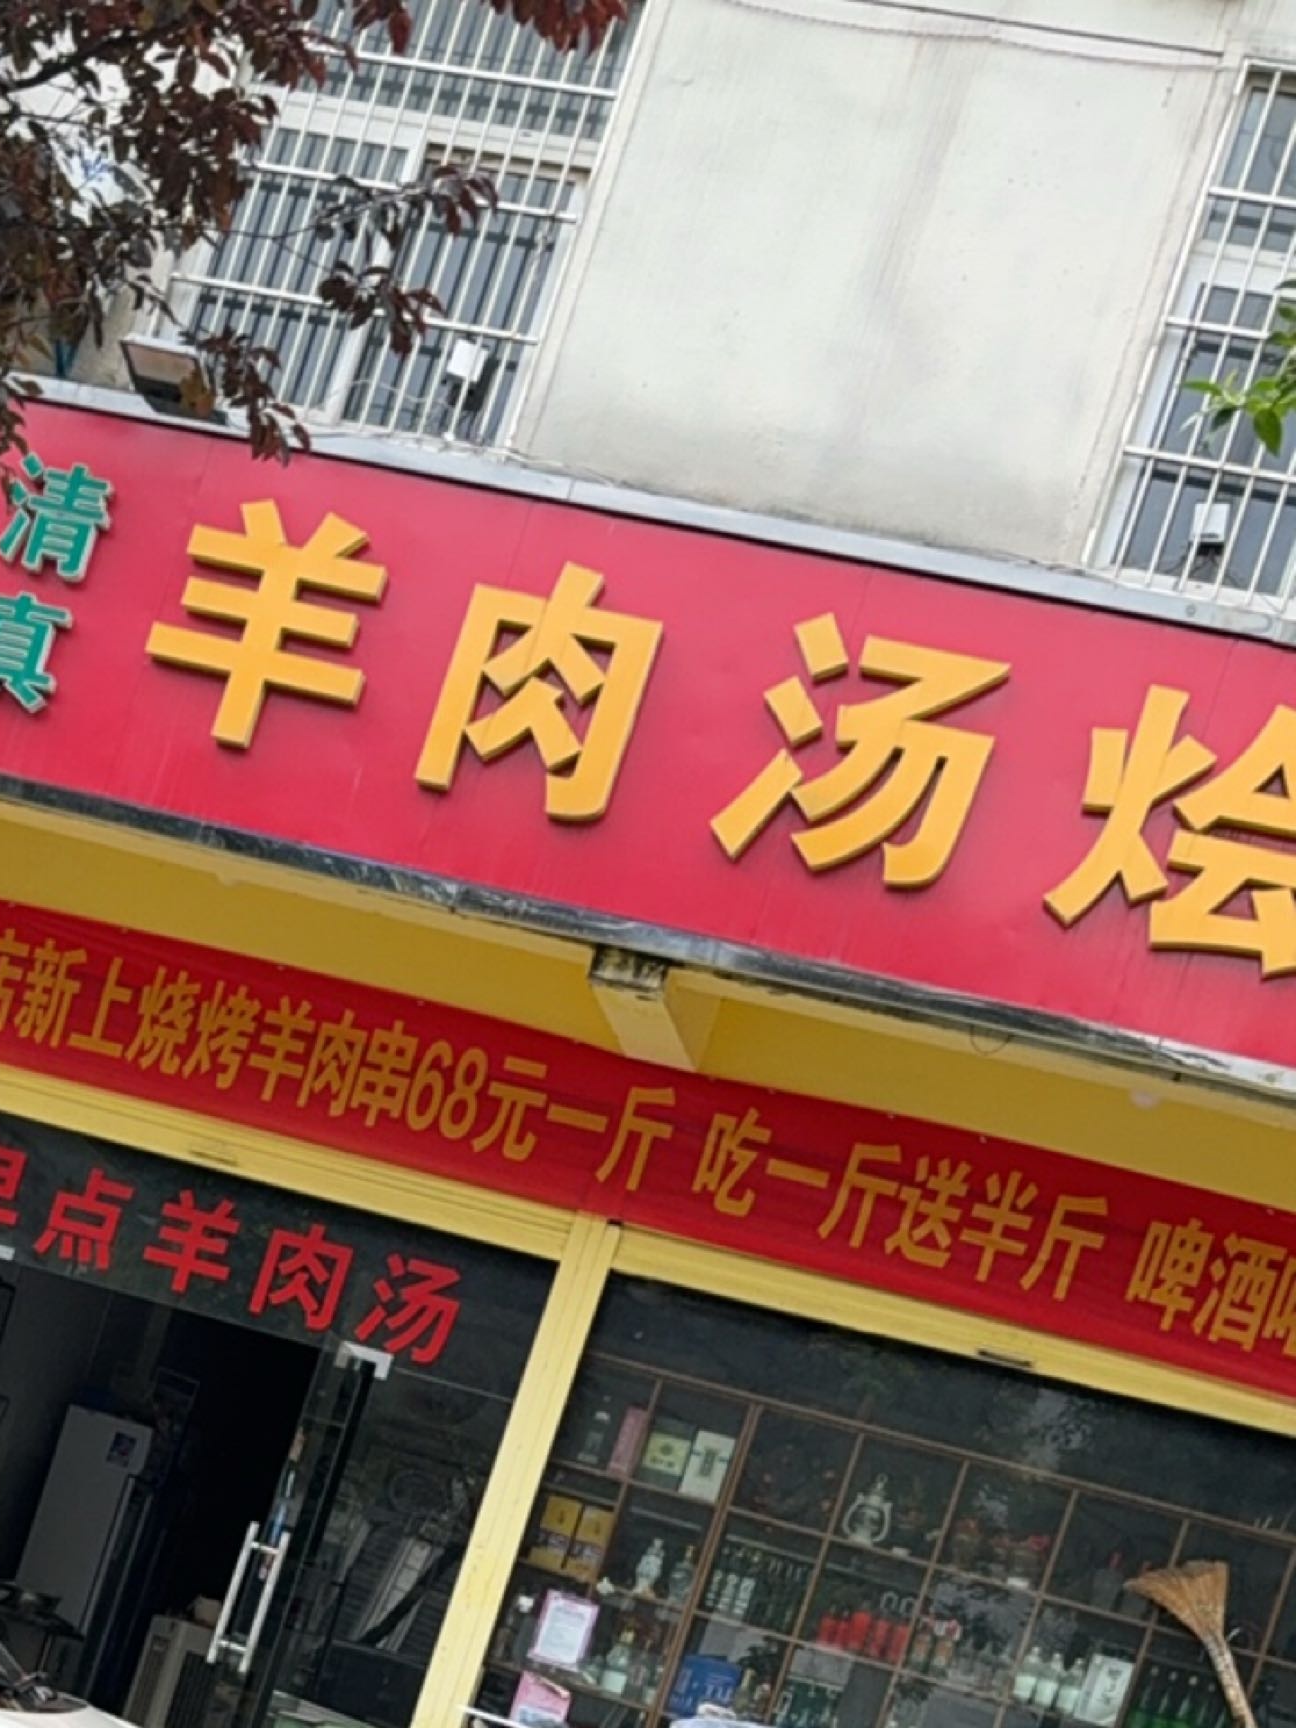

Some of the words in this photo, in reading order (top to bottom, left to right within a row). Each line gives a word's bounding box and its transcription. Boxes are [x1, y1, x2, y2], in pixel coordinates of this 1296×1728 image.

[144, 497, 1296, 981] 羊肉汤烩
[691, 1107, 1109, 1301] 吃一斤送半斤
